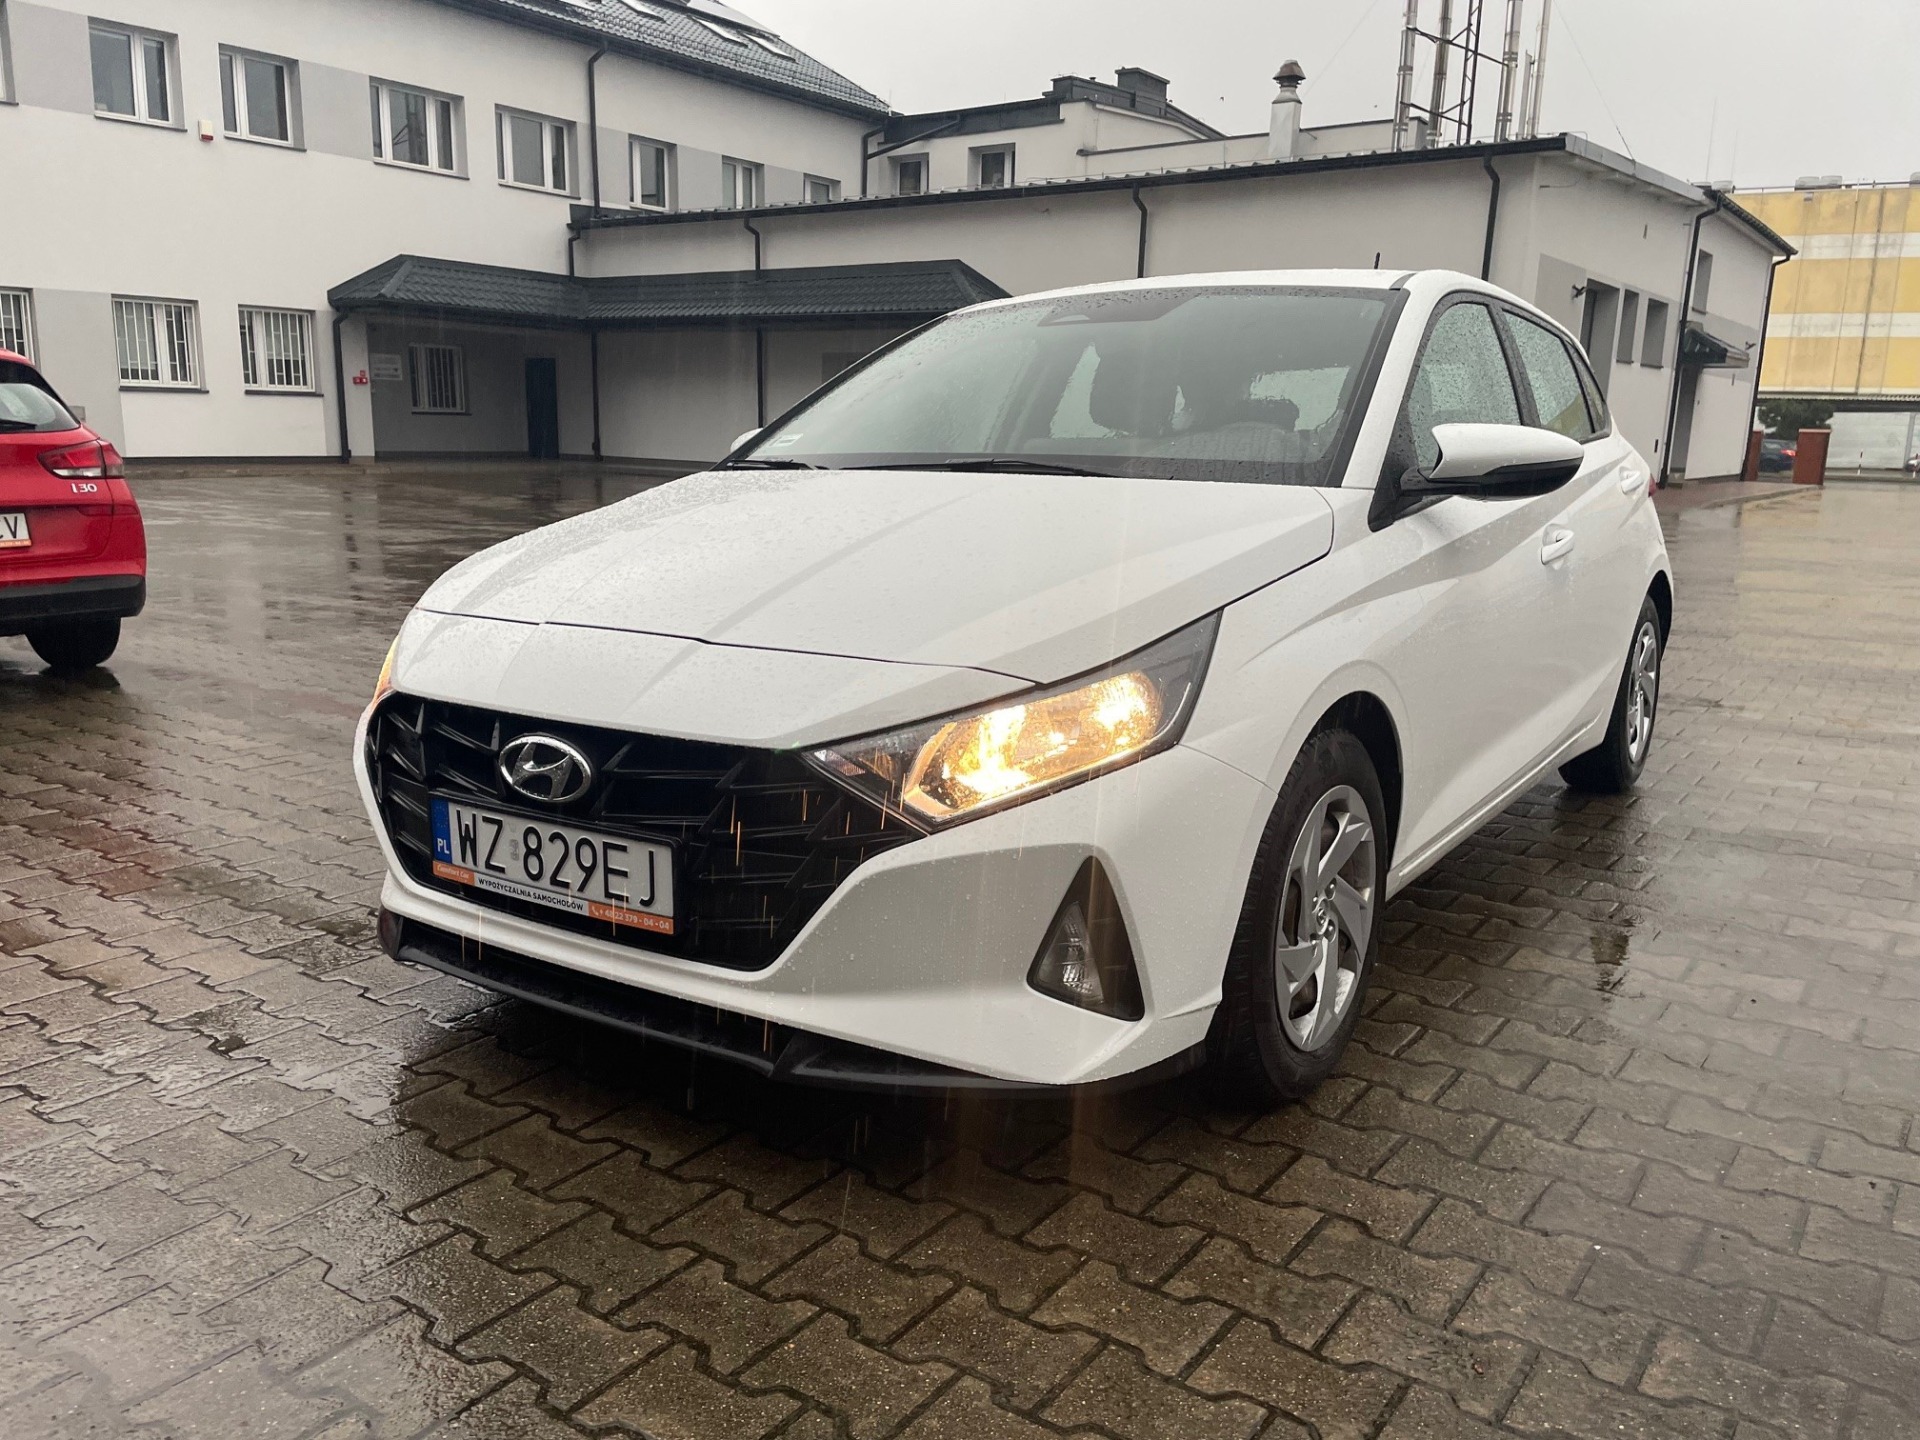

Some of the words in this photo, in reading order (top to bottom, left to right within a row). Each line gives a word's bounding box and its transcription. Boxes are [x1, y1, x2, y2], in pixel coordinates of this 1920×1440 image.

[0, 516, 18, 539] V
[437, 838, 450, 854] PL
[456, 809, 506, 874] WZ
[523, 826, 655, 907] 829EJ
[478, 878, 532, 898] WYPOŻYCZALNIA
[532, 892, 584, 911] SAMOCHODÓW
